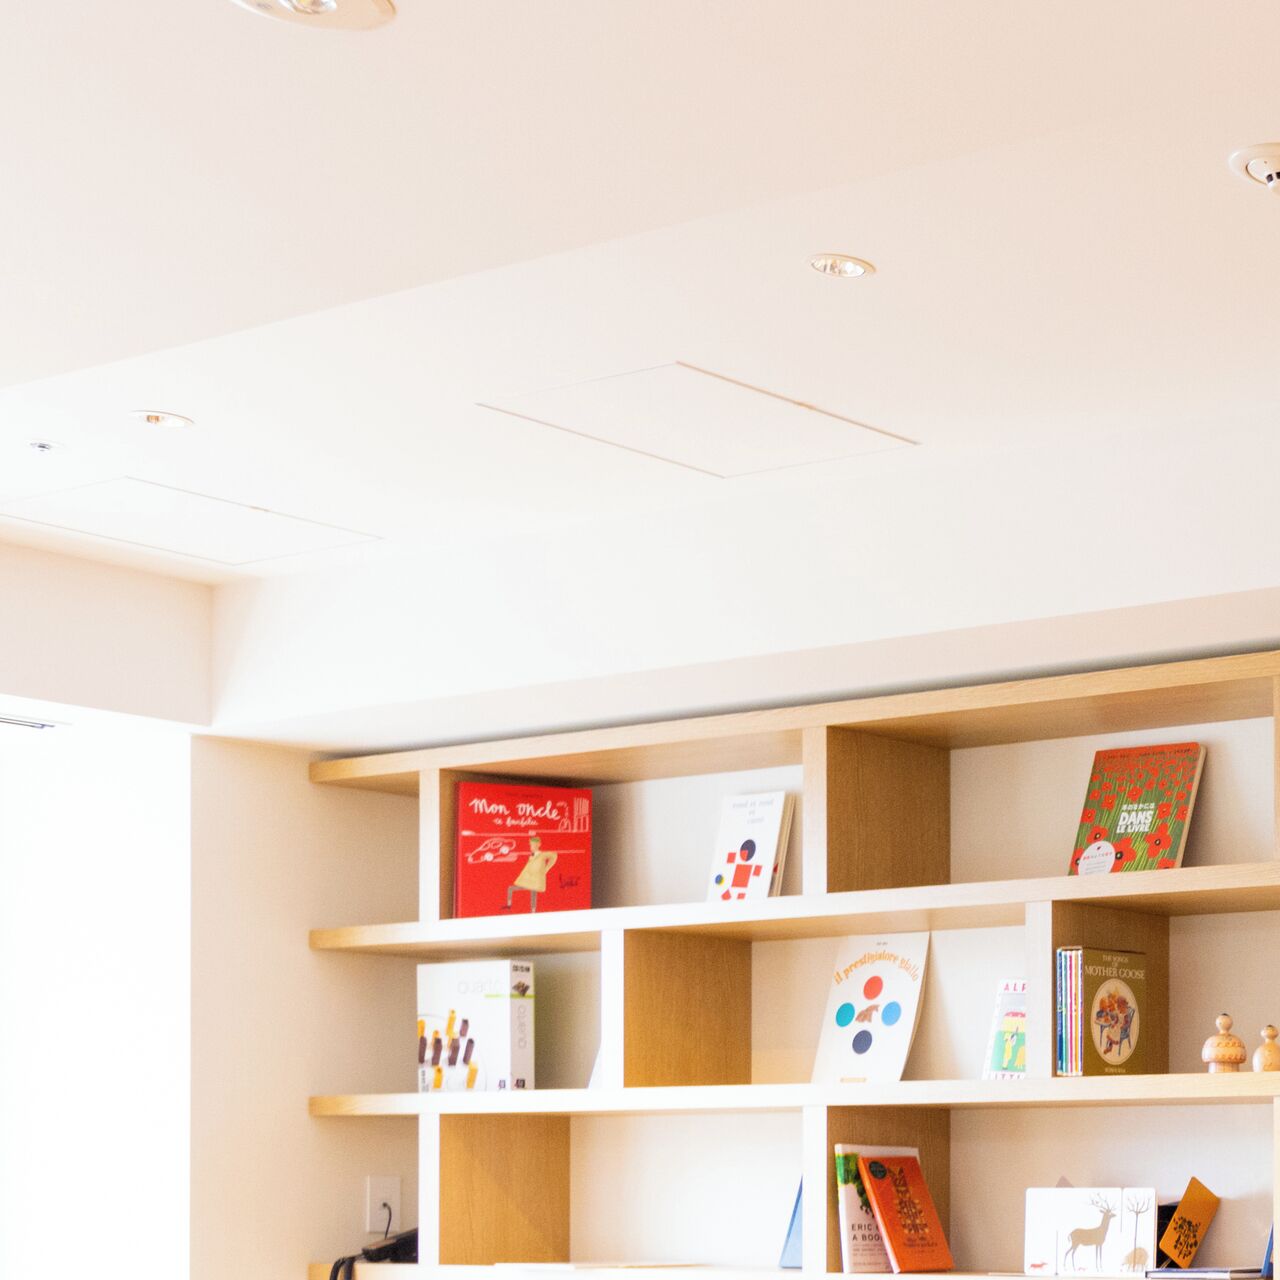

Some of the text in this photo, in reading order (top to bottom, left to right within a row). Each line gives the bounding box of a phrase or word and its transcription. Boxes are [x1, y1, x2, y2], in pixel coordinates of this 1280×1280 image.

[468, 798, 561, 820] Mon oncle
[1119, 811, 1154, 825] DANS
[1116, 823, 1150, 834] LE LIVRE
[1085, 965, 1145, 980] MOTHER GOOSE
[851, 1223, 872, 1232] ERIC
